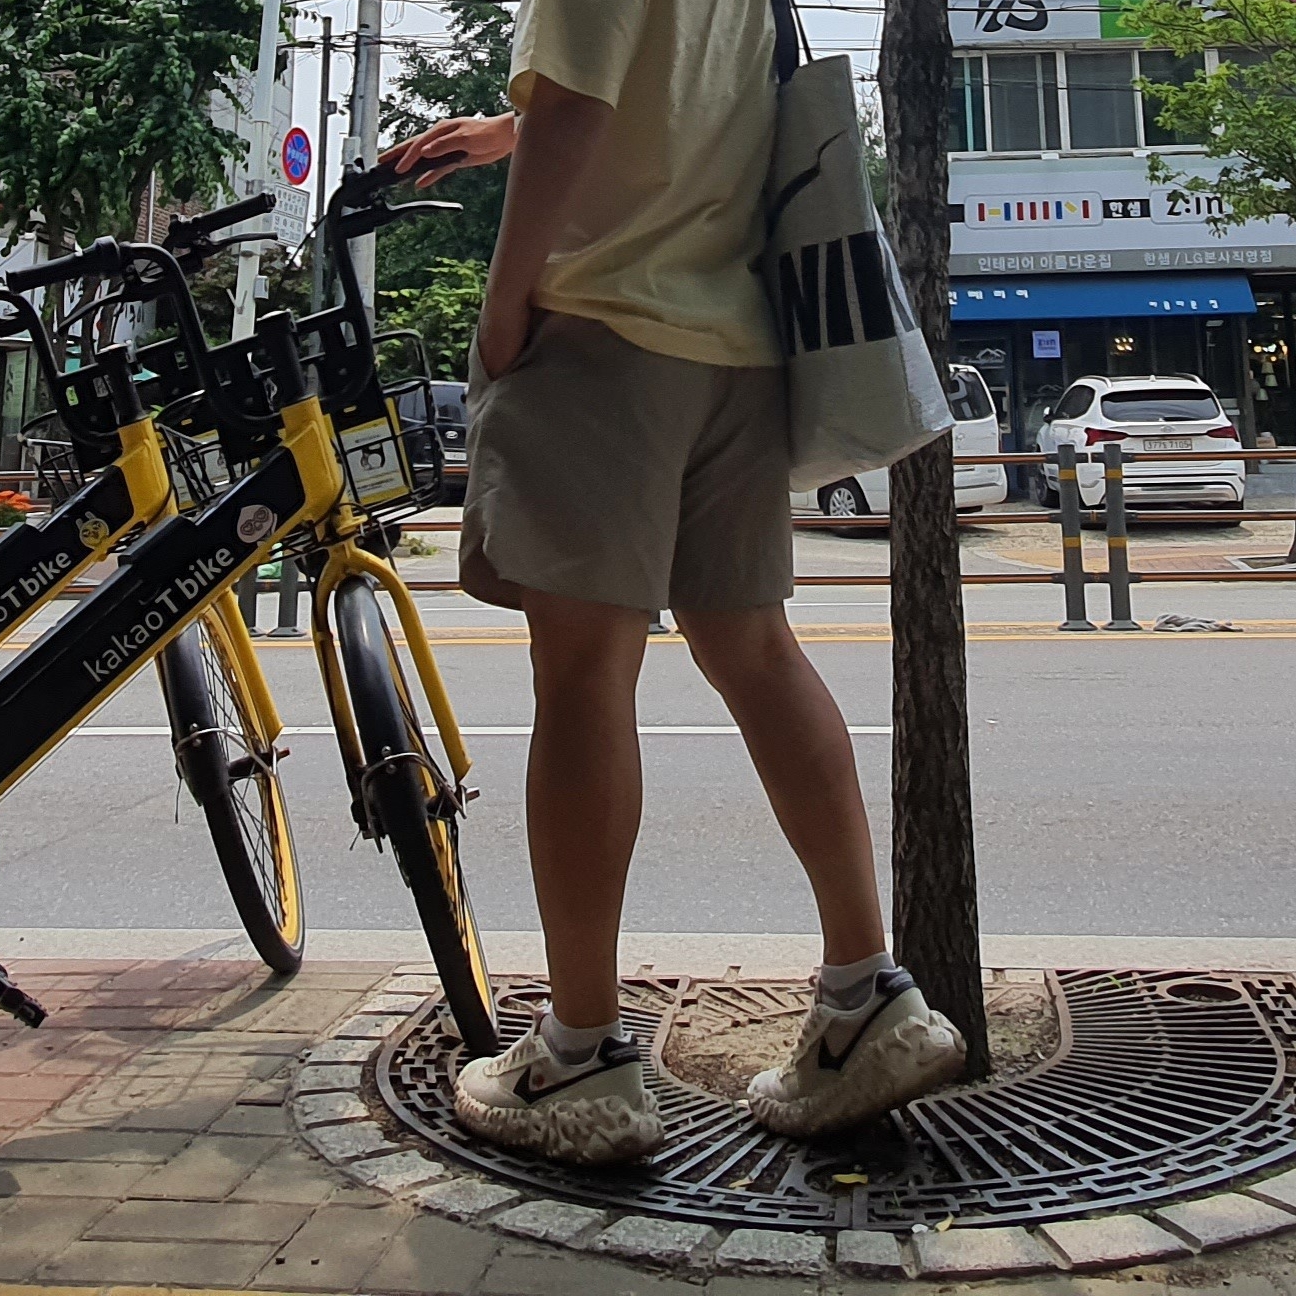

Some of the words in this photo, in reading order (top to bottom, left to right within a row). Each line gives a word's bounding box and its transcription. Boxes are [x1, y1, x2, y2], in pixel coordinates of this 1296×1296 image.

[1109, 201, 1141, 218] 한샘
[978, 256, 1035, 272] 인테리어
[1040, 254, 1112, 270] 아름다운집
[19, 552, 72, 597] bike
[174, 547, 235, 600] bike
